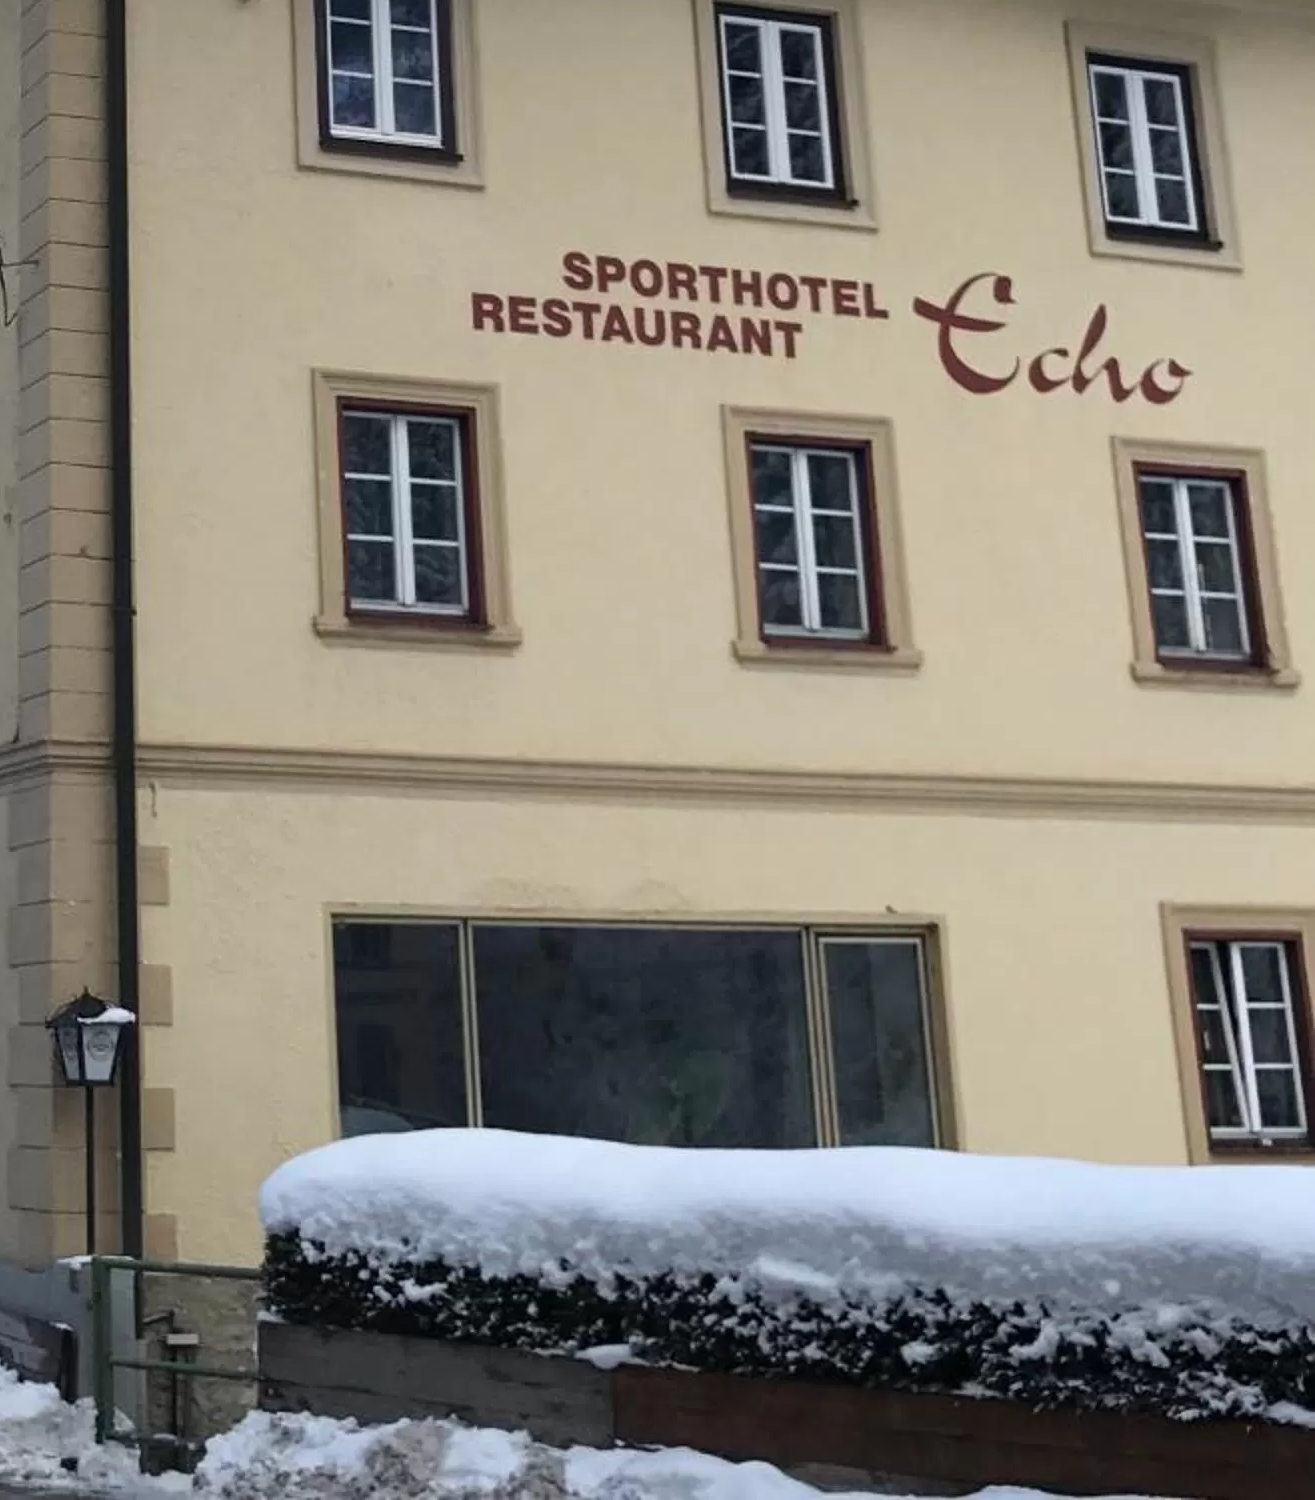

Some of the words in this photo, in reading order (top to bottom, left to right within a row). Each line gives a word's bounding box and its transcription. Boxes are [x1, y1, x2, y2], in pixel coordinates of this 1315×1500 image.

[562, 252, 889, 319] SPORTHOTEL
[471, 292, 803, 358] RESTAURANT
[913, 272, 1193, 404] Echo
